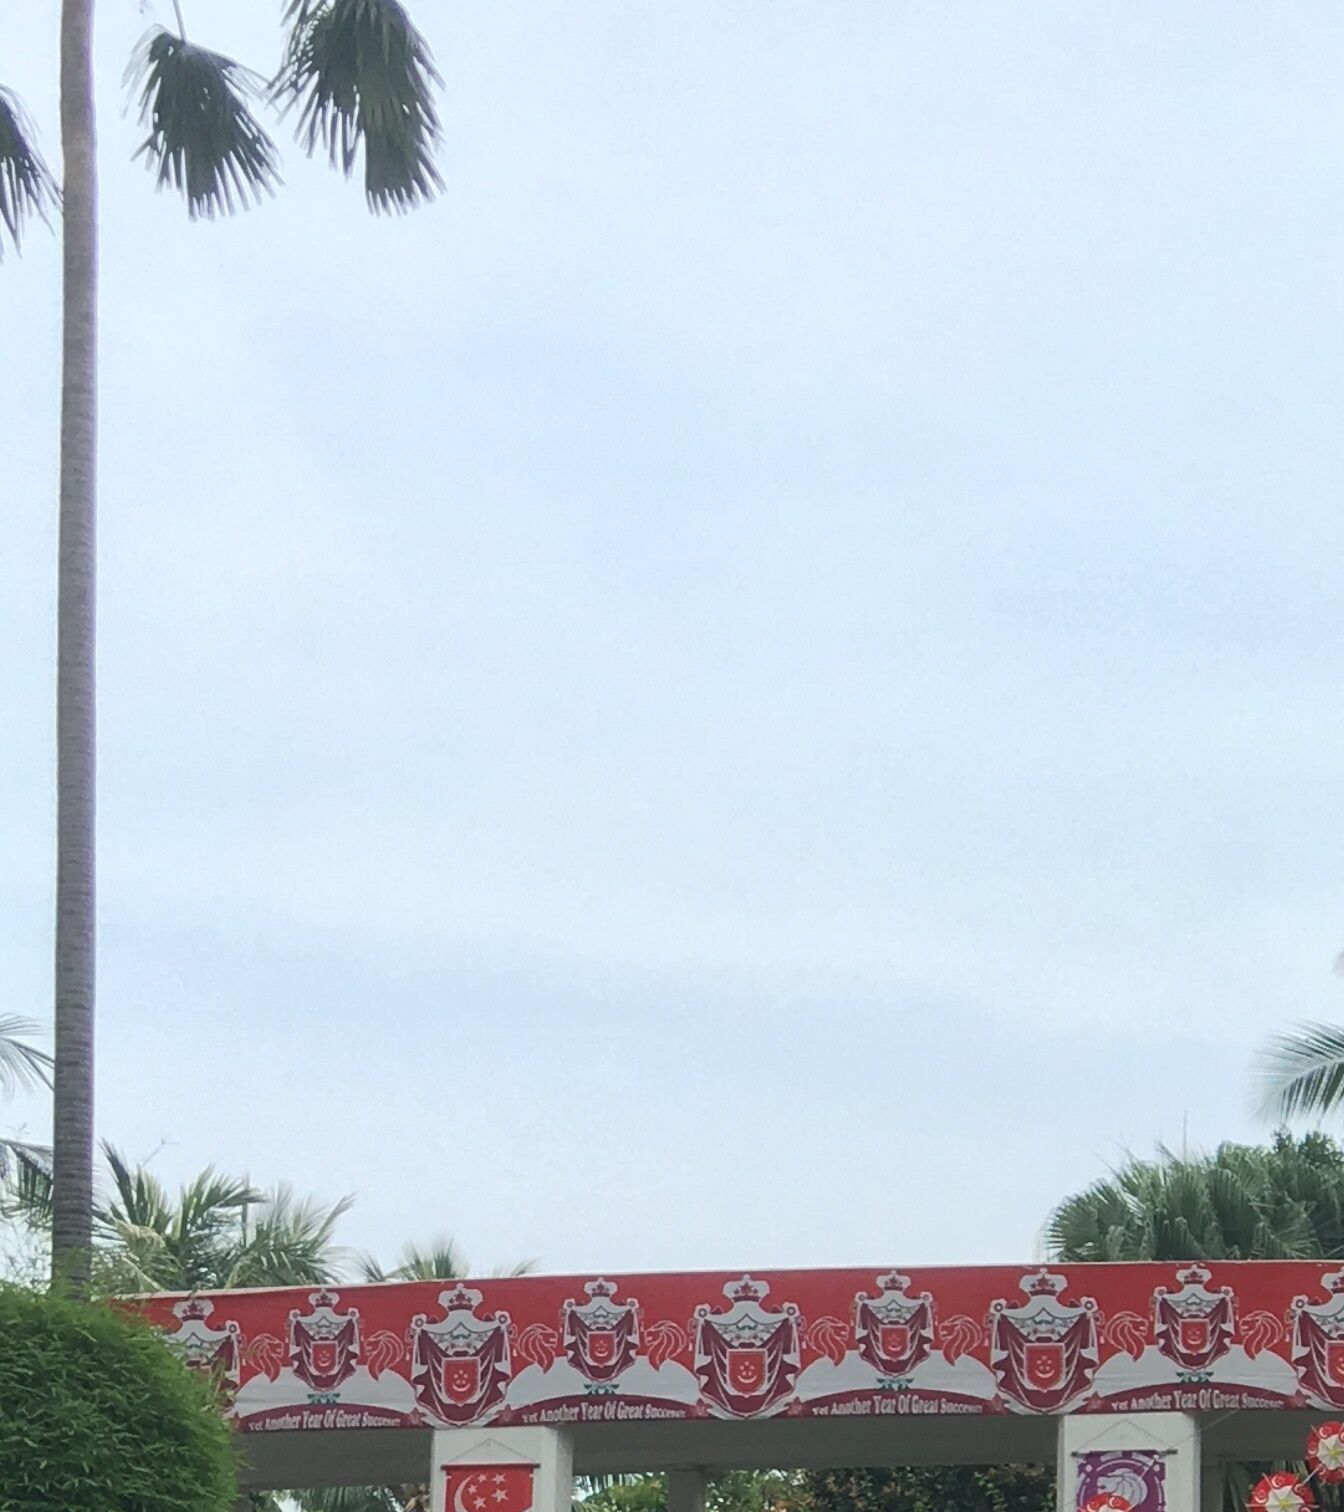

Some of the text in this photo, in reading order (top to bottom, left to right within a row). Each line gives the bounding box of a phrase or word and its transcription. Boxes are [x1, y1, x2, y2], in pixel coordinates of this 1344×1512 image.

[873, 1395, 896, 1414] Year
[1173, 1390, 1197, 1409] Year
[539, 1404, 579, 1422] Another
[581, 1402, 601, 1420] Year
[604, 1401, 615, 1420] Of
[617, 1402, 642, 1419] Great
